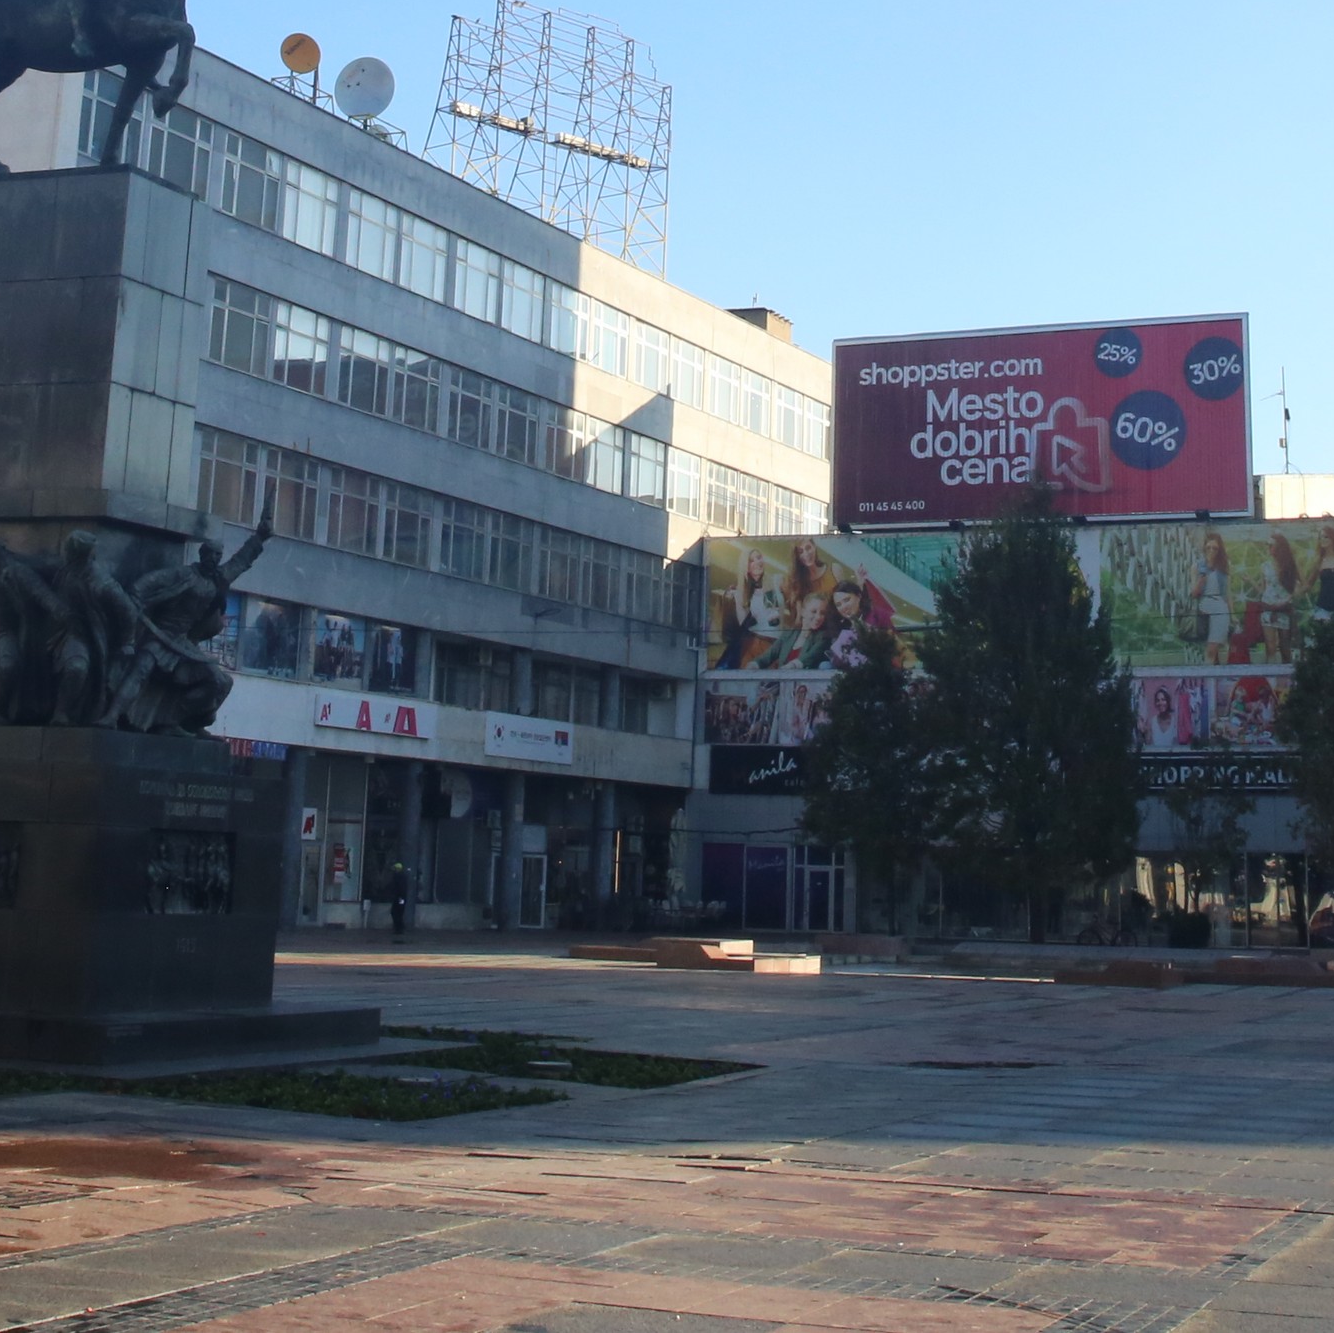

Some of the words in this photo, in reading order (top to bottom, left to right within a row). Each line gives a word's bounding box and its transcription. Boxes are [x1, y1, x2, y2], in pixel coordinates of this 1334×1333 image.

[1097, 343, 1137, 364] 25%
[859, 357, 1043, 388] shoppster.com
[1189, 354, 1241, 385] 30%
[926, 386, 1044, 423] Mesto
[910, 420, 1032, 459] dobrih
[1115, 412, 1180, 451] 60%
[940, 454, 1032, 486] cena
[859, 502, 874, 512] 011
[876, 502, 889, 511] 45
[890, 501, 903, 511] 45
[905, 500, 925, 510] 400
[1140, 765, 1240, 784] OPPNG
[1245, 765, 1299, 784] MAL
